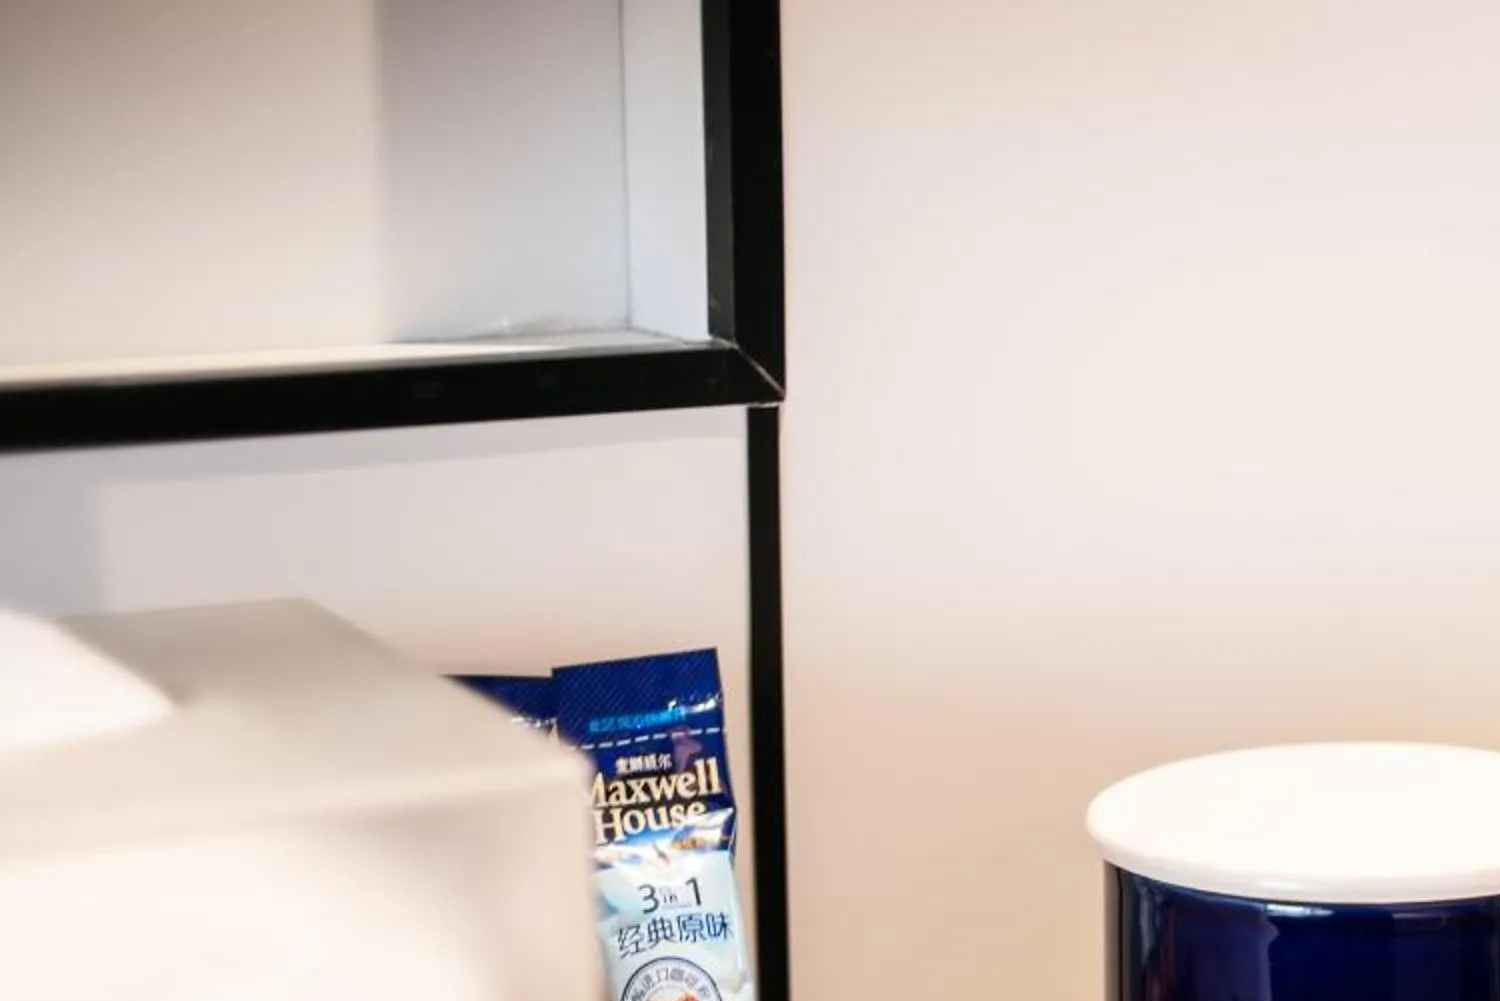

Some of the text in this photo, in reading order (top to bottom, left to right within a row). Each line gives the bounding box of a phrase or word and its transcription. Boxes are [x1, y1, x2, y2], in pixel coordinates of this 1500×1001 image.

[592, 801, 707, 846] House
[638, 884, 660, 914] 3
[685, 877, 702, 906] 1
[617, 911, 733, 958] 经典原味
